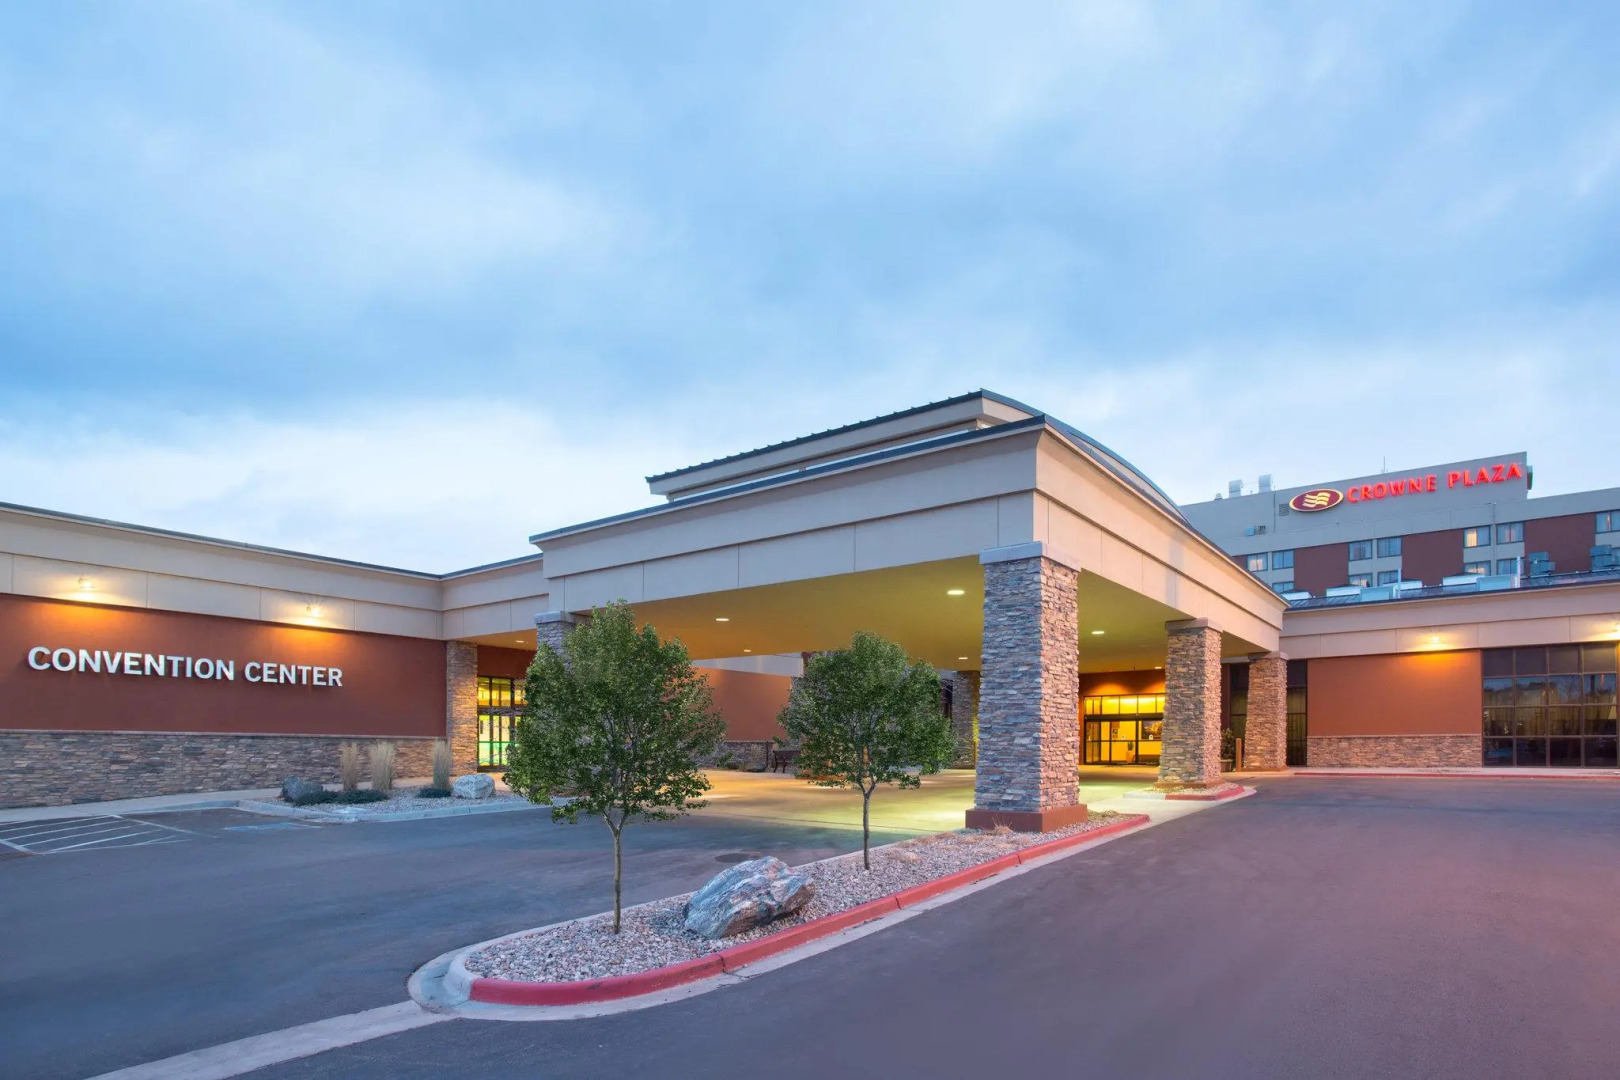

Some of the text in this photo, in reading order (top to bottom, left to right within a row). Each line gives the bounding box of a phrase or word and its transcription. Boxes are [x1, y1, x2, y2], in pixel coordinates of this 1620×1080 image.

[1346, 462, 1522, 502] CROWNE PLAZA
[27, 646, 343, 687] CONVENTION CENTER
